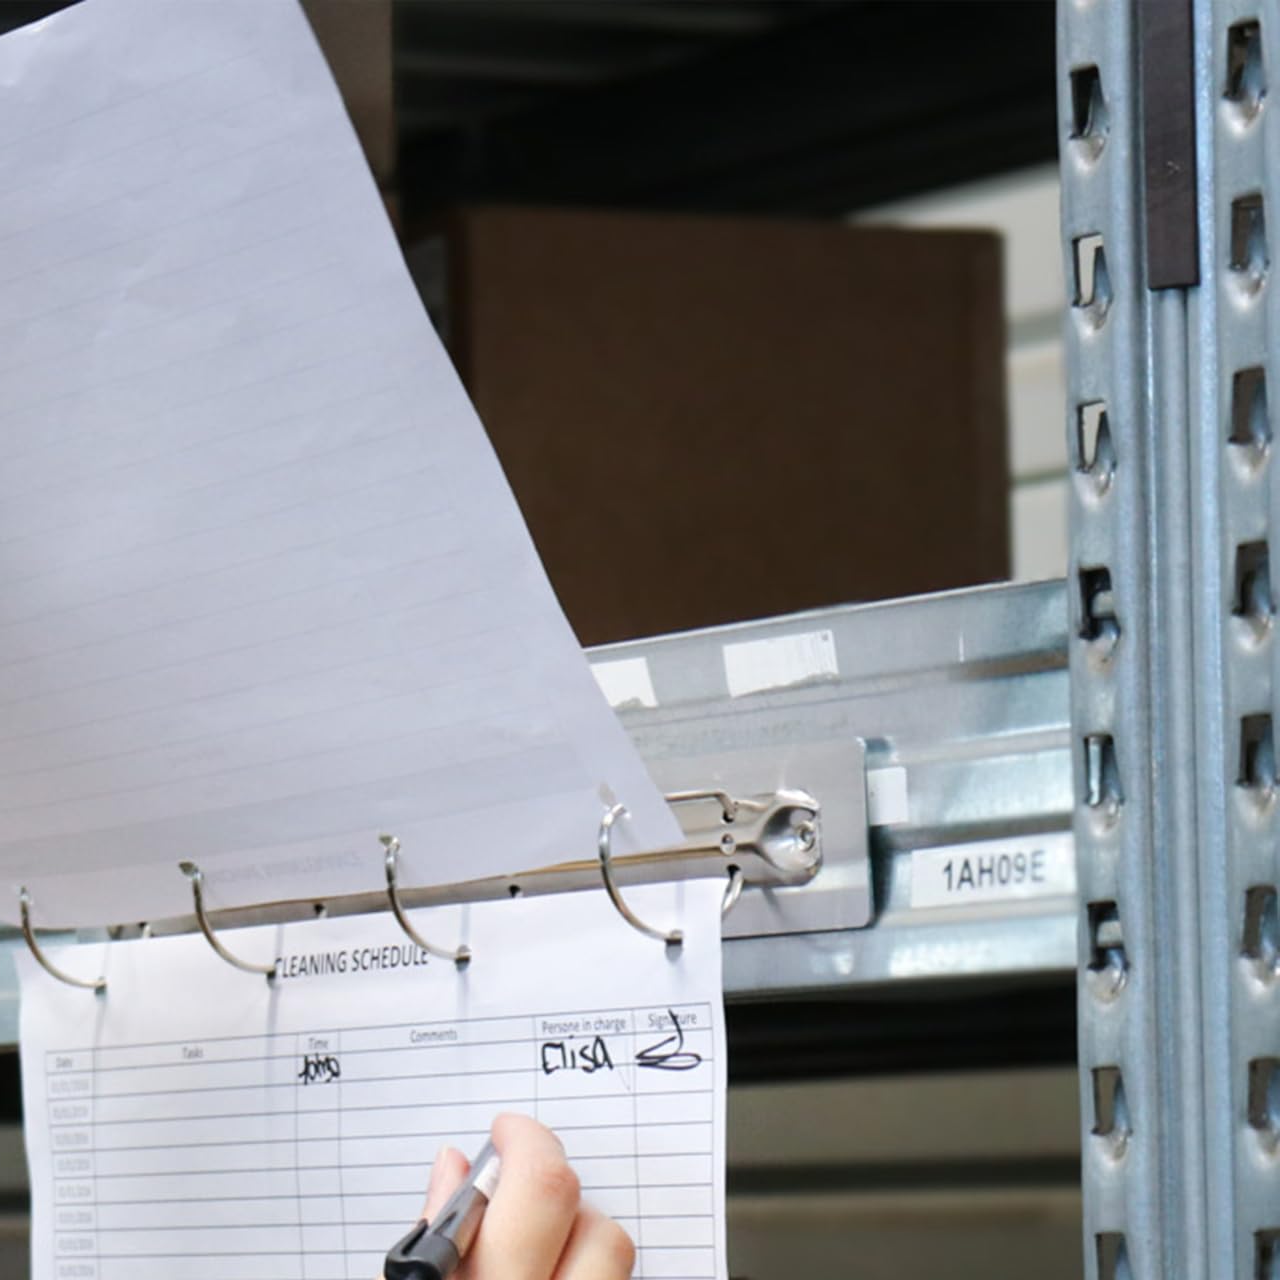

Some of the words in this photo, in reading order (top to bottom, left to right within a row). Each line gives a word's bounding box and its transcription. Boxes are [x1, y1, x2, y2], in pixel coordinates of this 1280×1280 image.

[943, 850, 1046, 892] 1AH09E
[351, 944, 429, 973] SCHEDULE
[409, 1029, 458, 1044] Comments
[542, 1019, 580, 1034] Persone
[582, 1018, 592, 1031] in
[593, 1016, 626, 1033] charge
